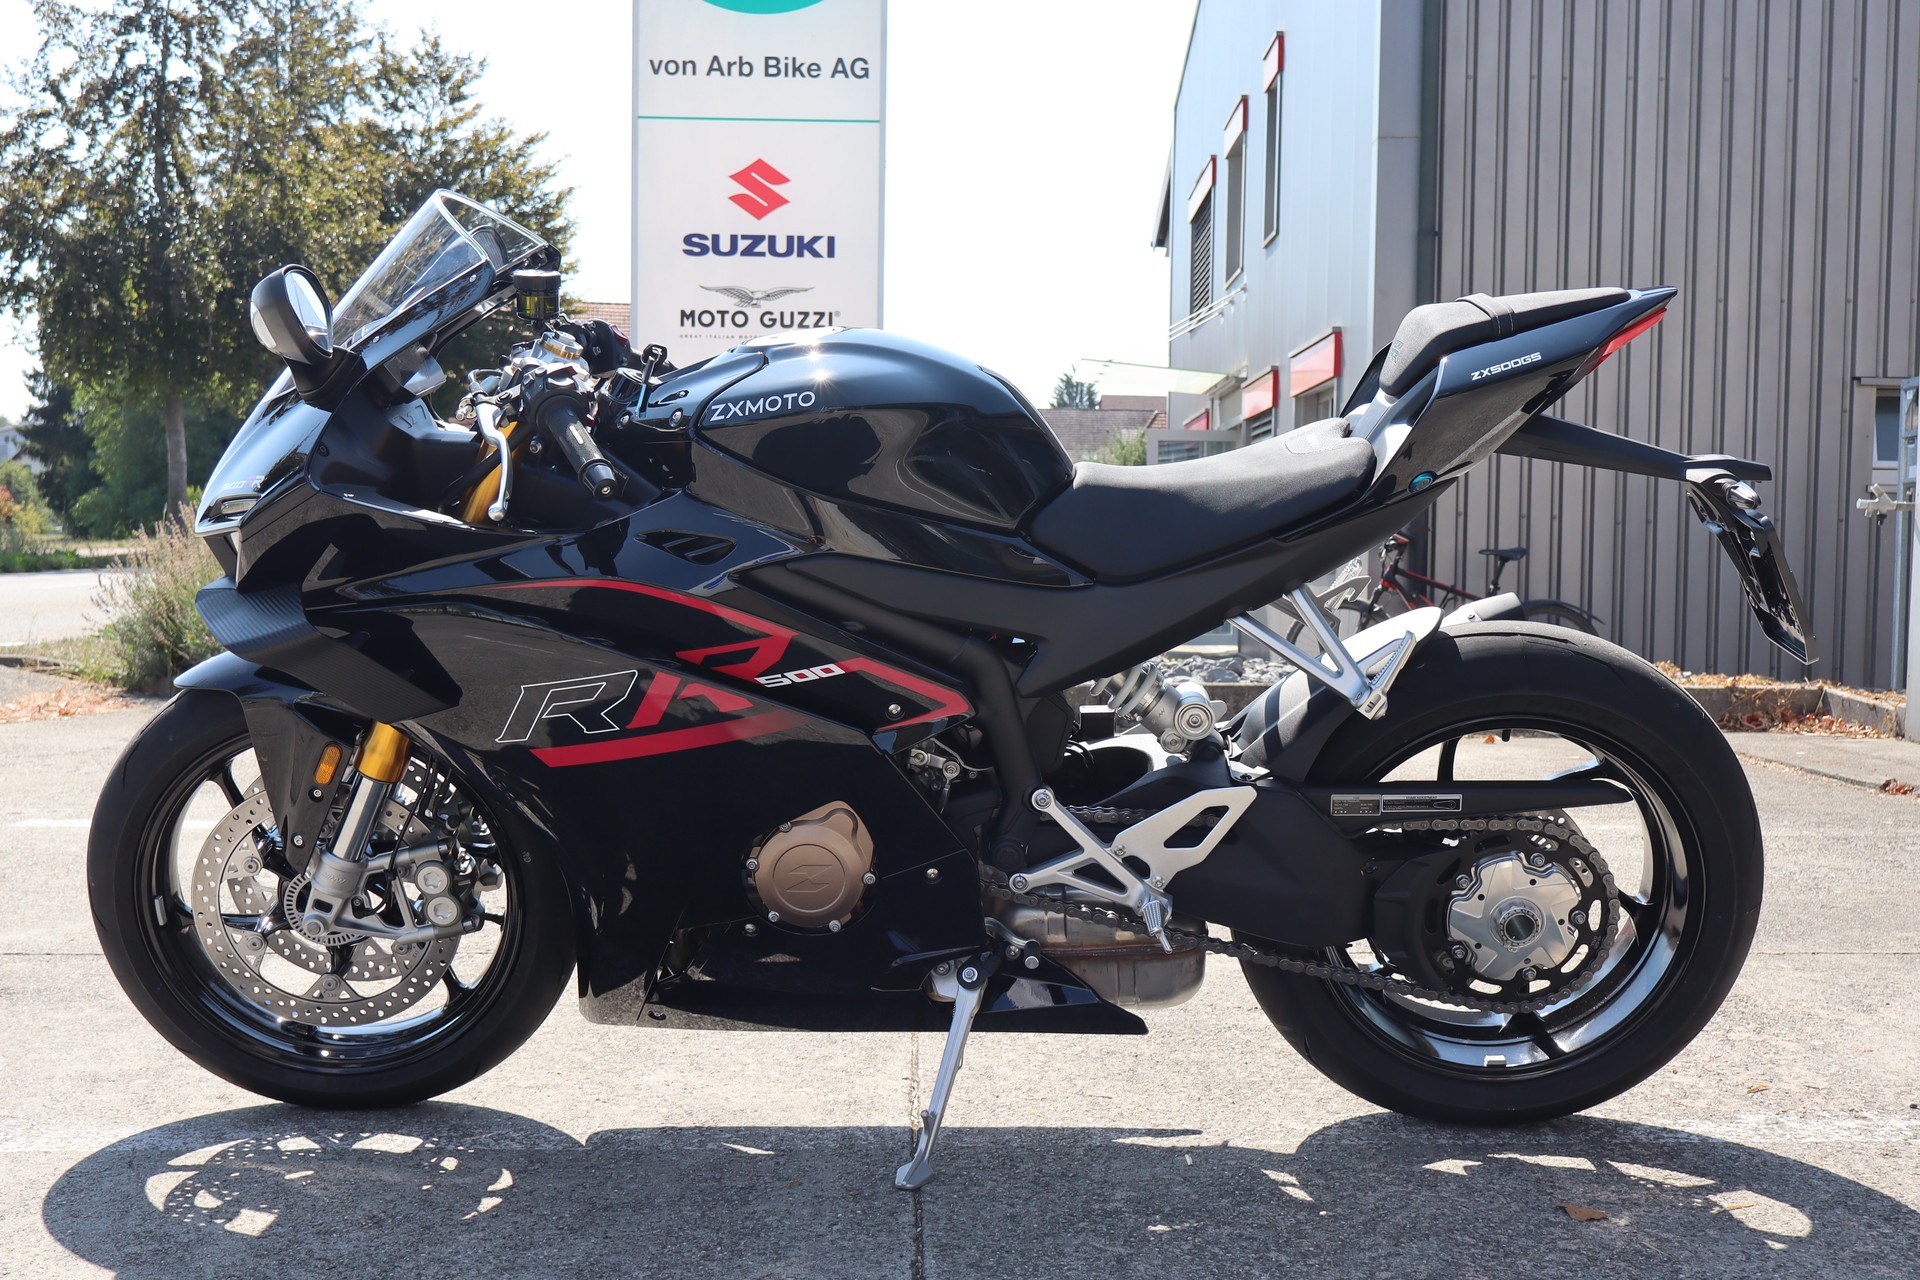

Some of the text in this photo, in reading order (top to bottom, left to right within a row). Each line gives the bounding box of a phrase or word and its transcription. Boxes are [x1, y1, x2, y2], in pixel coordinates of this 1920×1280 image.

[649, 55, 870, 79] von Arb Bike AG
[682, 233, 835, 259] SUZUKI
[680, 309, 749, 328] MOTO
[1470, 351, 1542, 381] ZX500GS
[709, 391, 816, 422] ZXMOTO
[753, 663, 847, 688] 500
